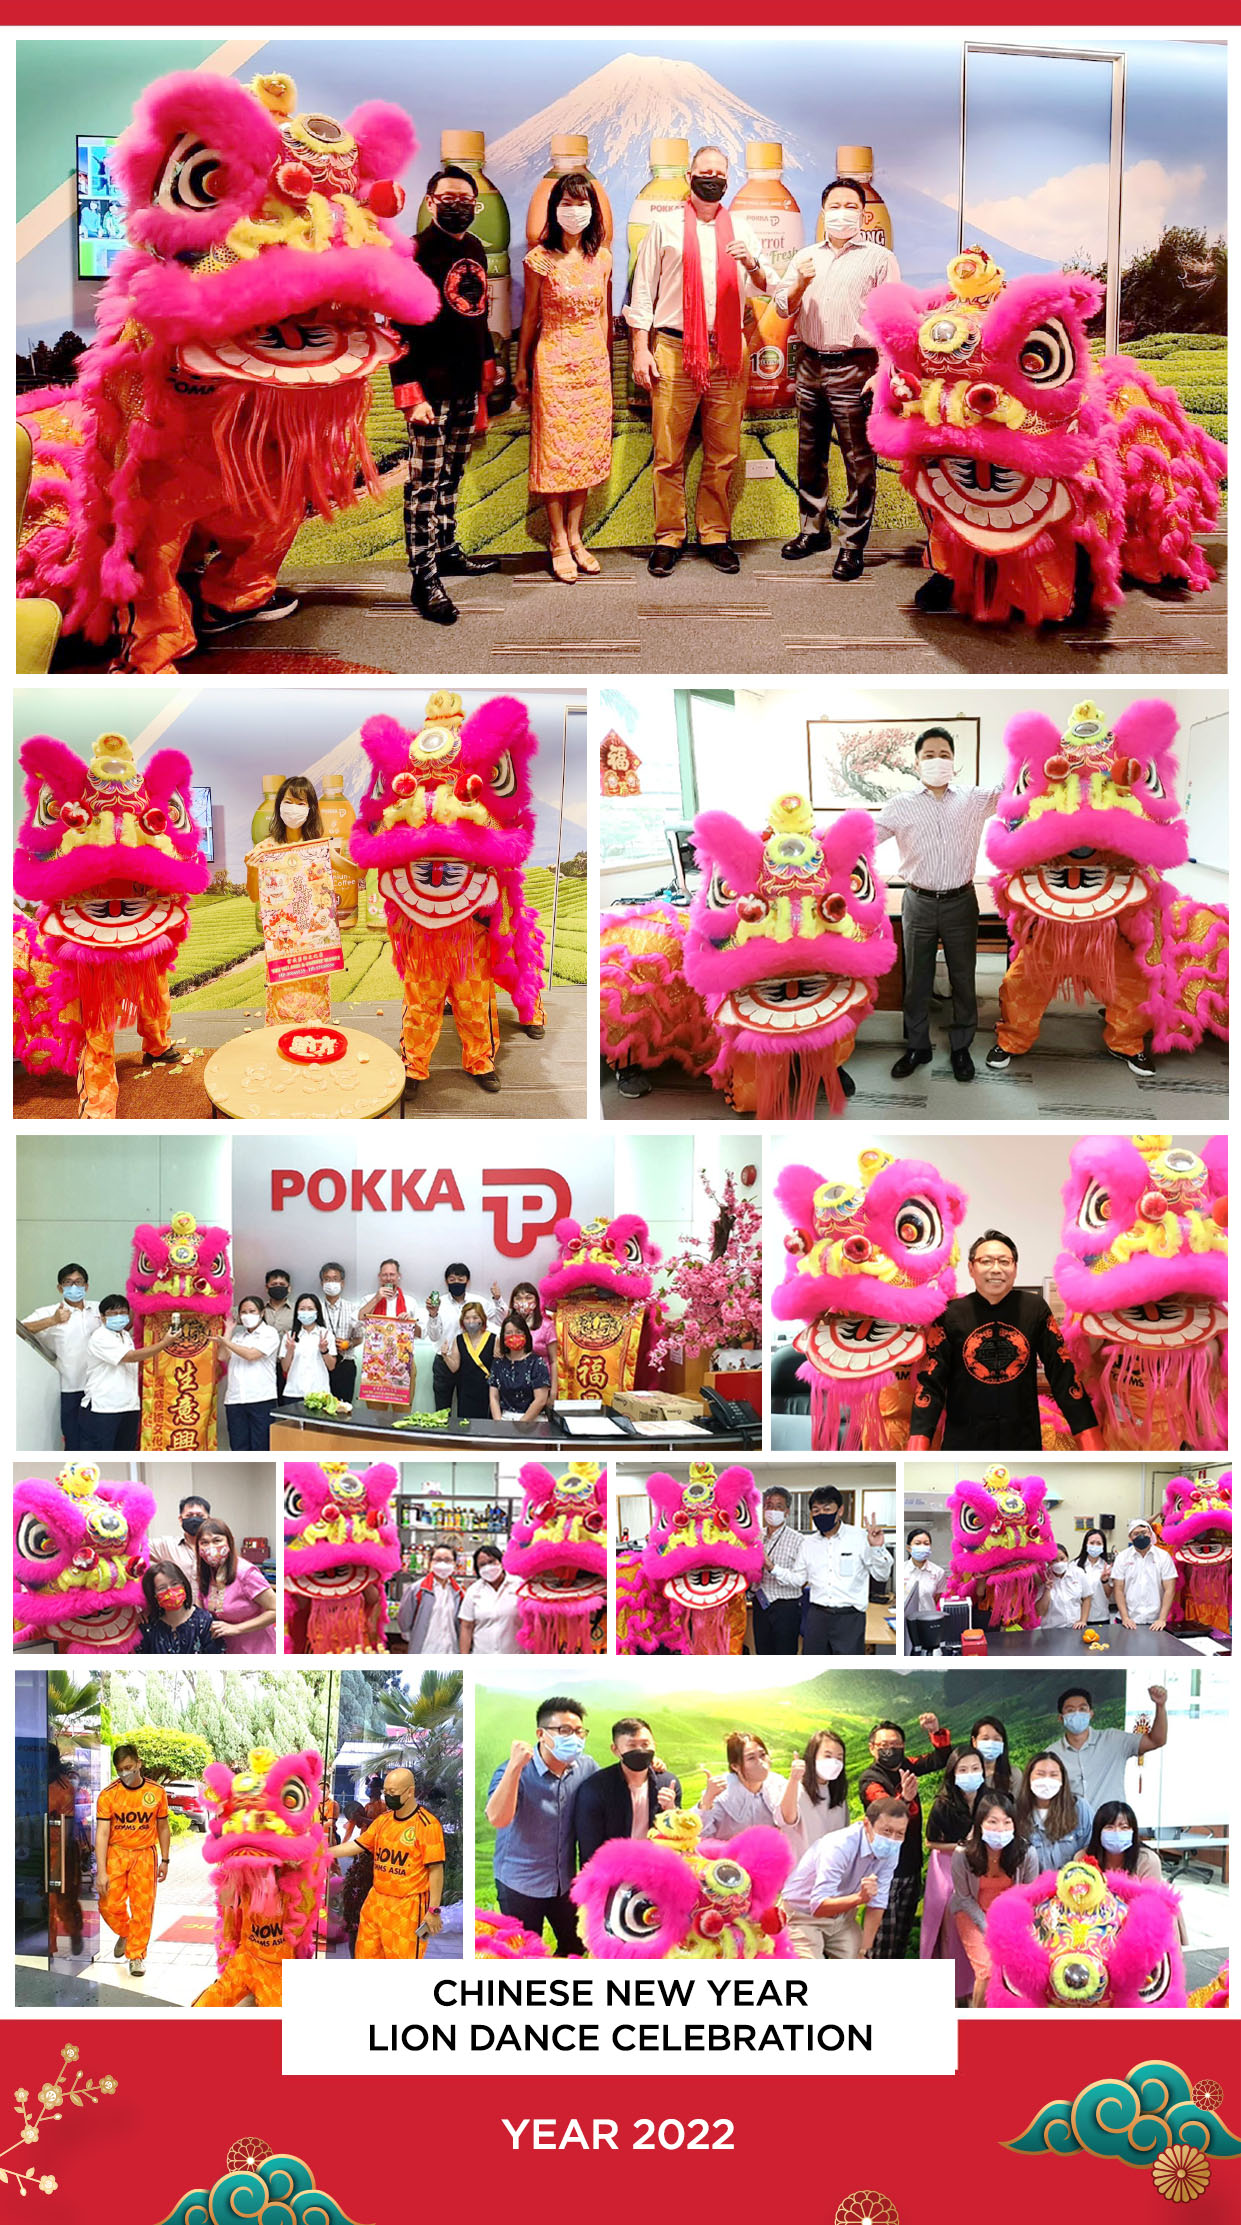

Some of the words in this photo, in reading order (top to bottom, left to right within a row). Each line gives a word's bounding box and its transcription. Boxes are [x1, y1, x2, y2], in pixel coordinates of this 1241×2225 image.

[607, 744, 630, 771] 福
[271, 1168, 465, 1212] POKKA
[114, 1811, 154, 1824] NOW
[388, 1867, 406, 1876] ASIA
[251, 1922, 283, 1939] NOW
